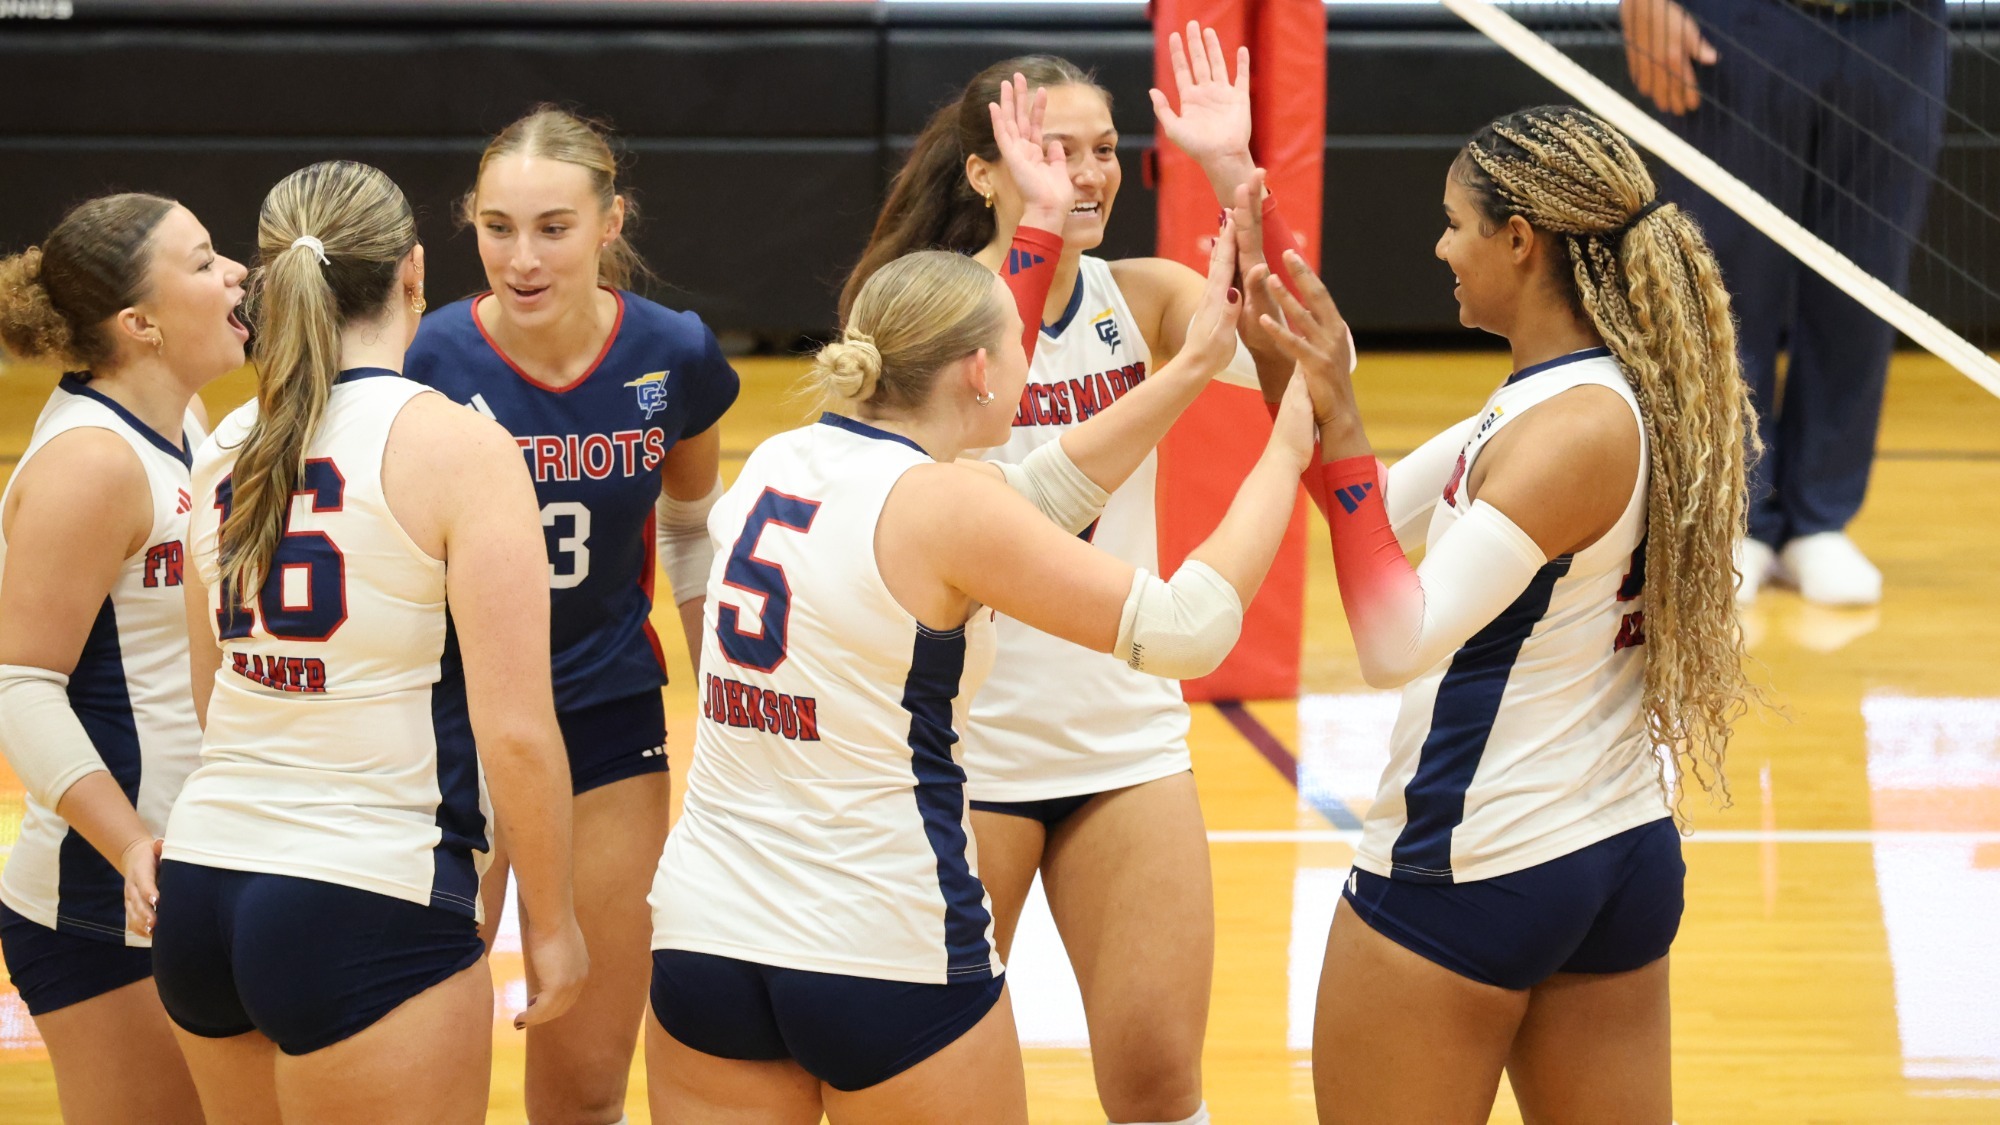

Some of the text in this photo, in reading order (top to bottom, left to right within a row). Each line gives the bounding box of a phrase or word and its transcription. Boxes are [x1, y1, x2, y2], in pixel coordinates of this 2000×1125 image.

[1011, 381, 1072, 426] NCIS
[143, 539, 184, 588] FR
[213, 457, 348, 642] 16
[541, 502, 591, 589] 3
[716, 486, 822, 674] 5
[704, 673, 821, 741] JOHNSON
